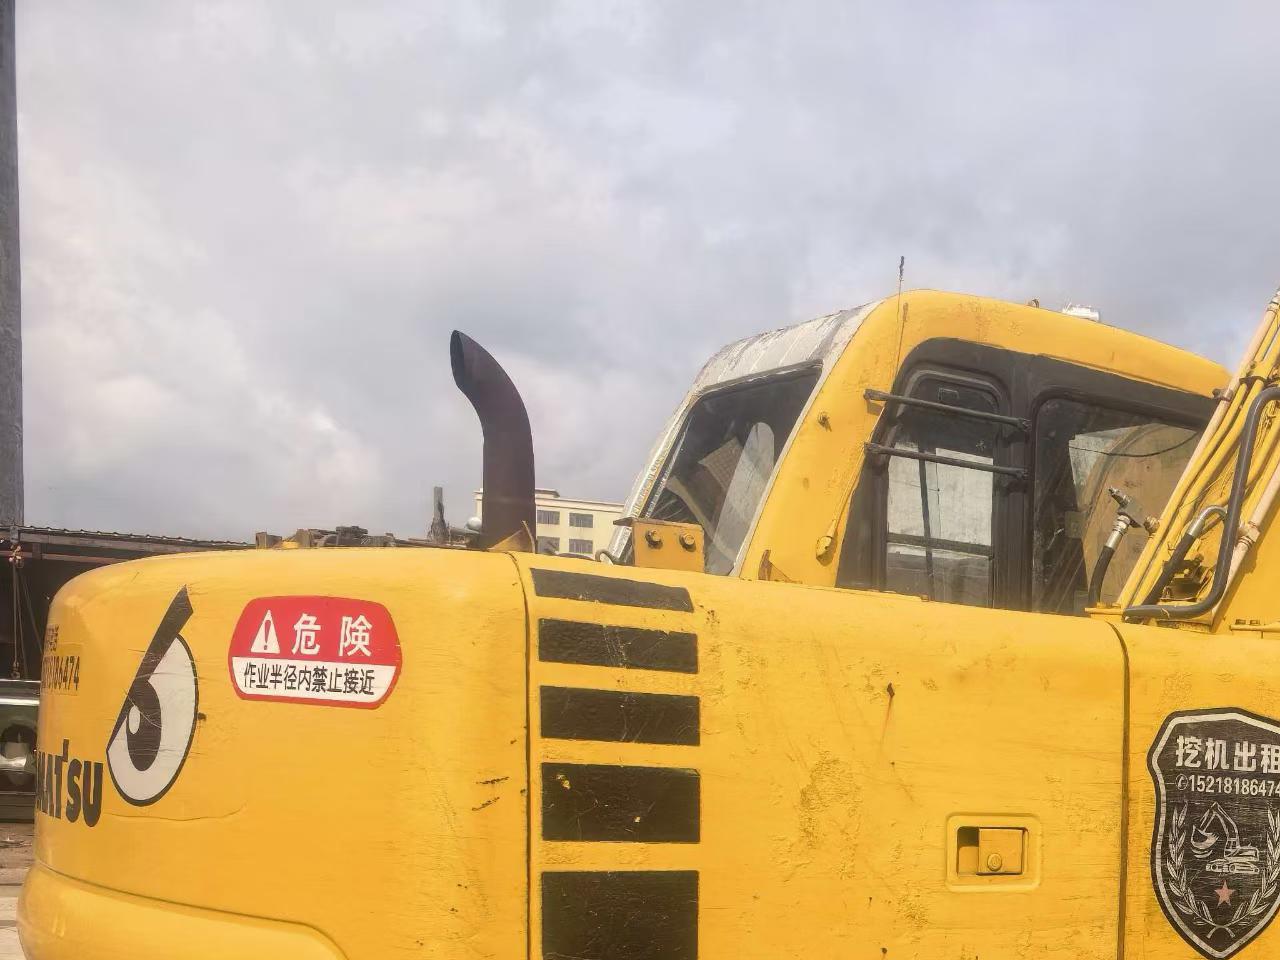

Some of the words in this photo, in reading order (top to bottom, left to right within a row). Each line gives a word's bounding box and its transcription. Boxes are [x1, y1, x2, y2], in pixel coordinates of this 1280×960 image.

[244, 661, 375, 696] 作业半径内禁止接近
